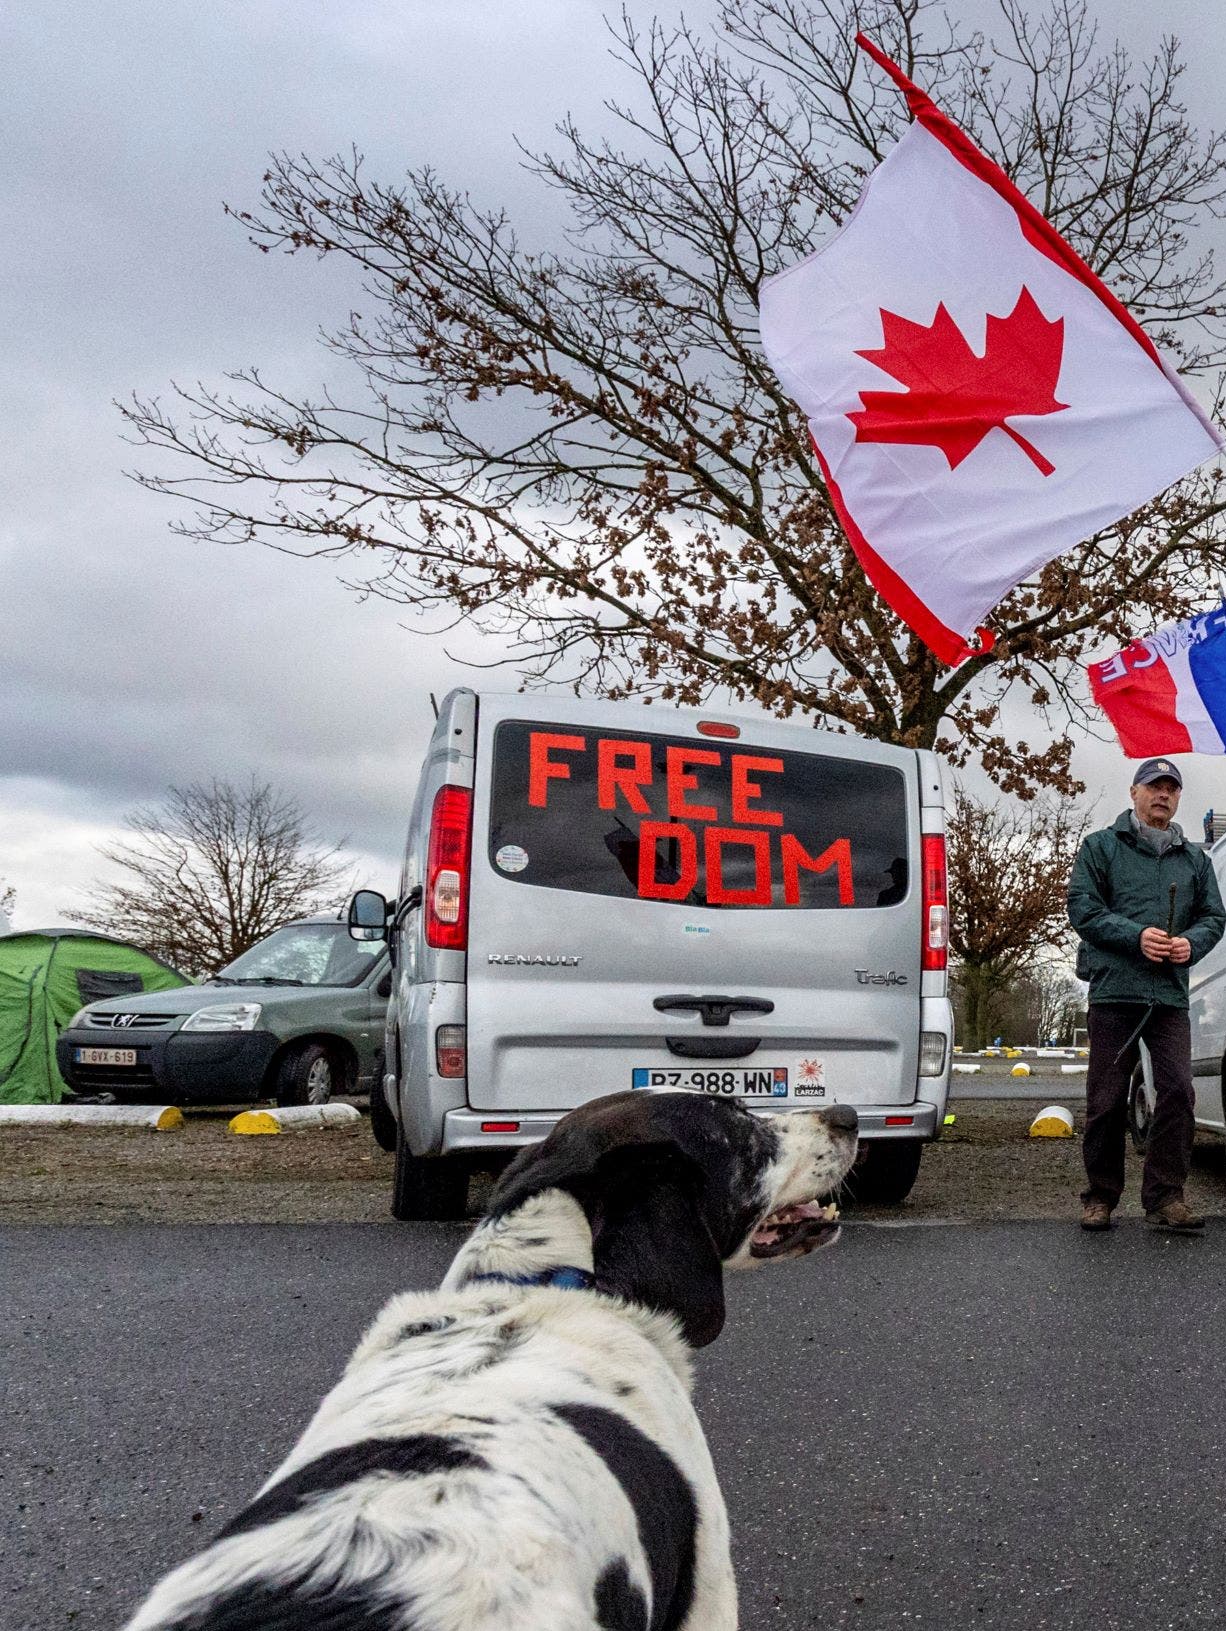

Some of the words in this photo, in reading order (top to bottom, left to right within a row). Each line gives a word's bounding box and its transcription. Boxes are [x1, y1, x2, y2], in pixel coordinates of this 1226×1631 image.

[529, 732, 784, 827] FREE
[638, 821, 855, 905] DOM
[488, 954, 582, 966] RENAULT
[854, 968, 908, 986] Trafic
